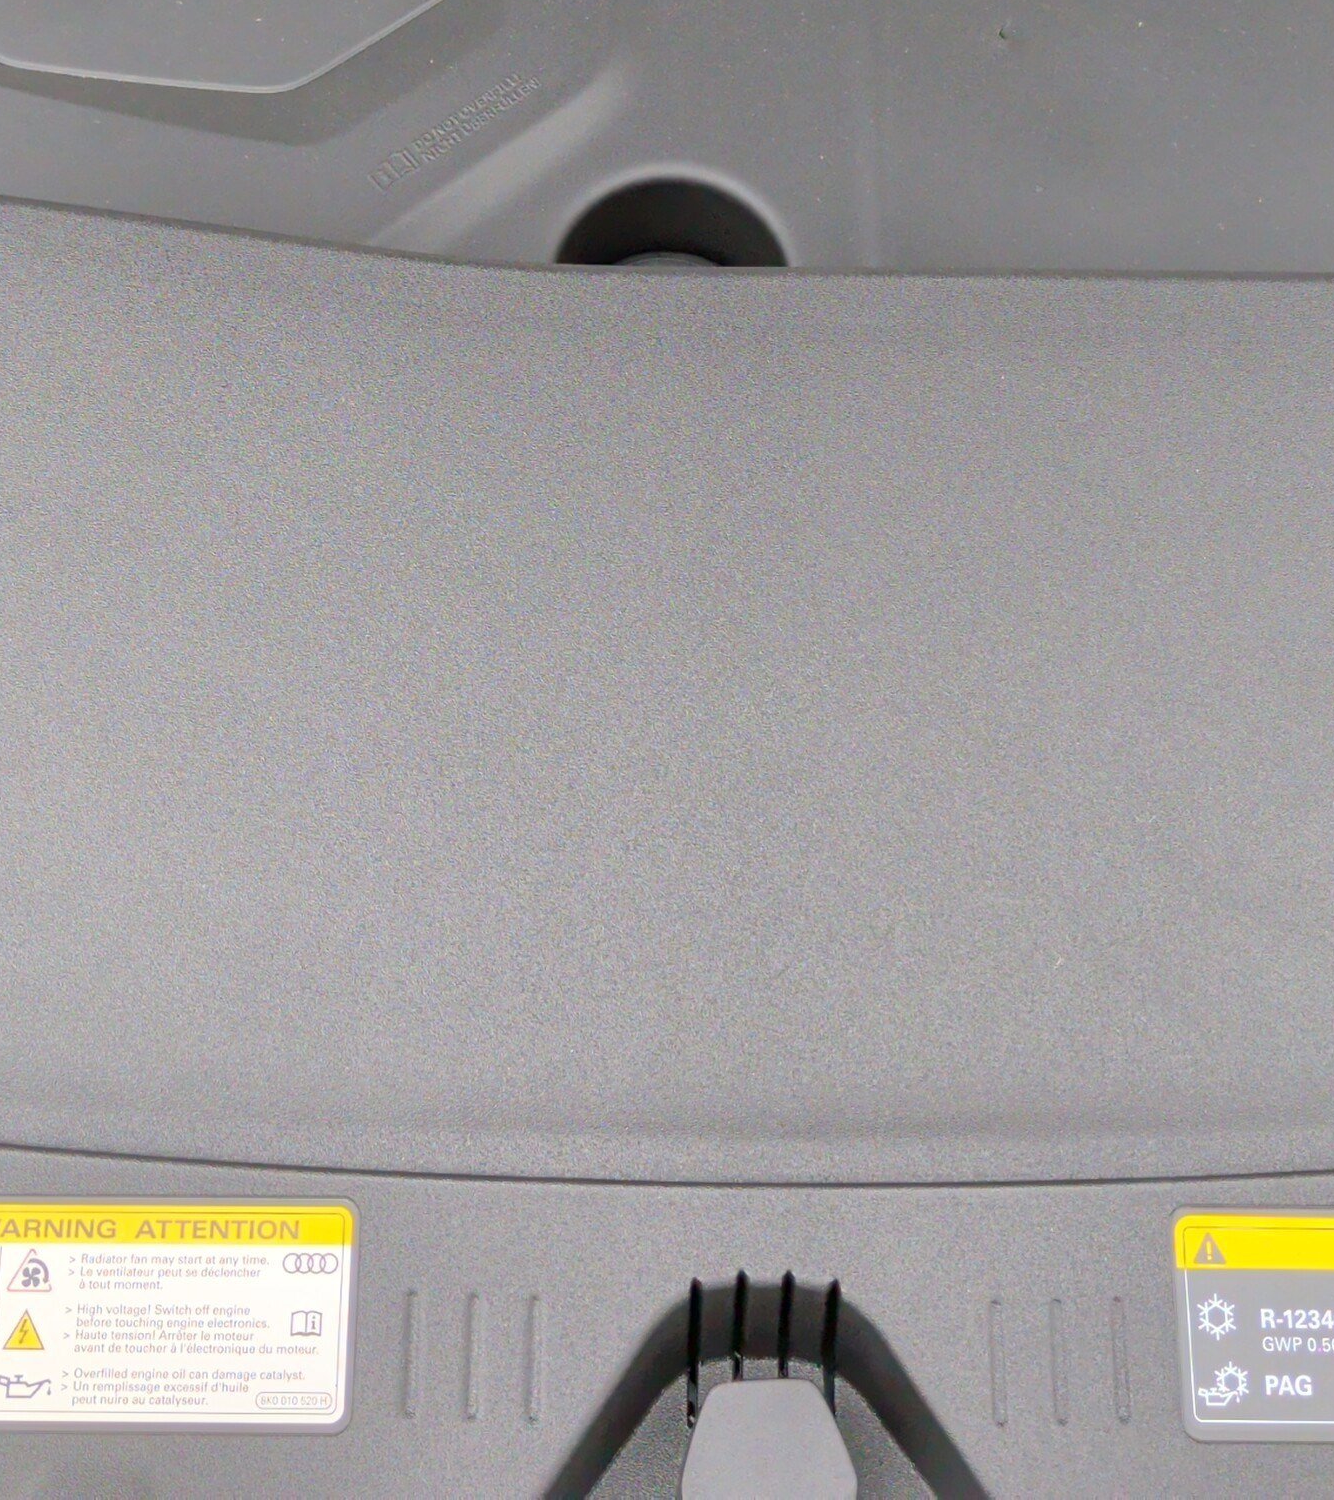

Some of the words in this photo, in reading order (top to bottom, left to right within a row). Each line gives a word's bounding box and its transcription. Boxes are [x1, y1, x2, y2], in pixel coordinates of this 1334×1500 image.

[135, 1220, 301, 1240] ATTENTION
[81, 1253, 127, 1265] Radiator
[130, 1254, 148, 1265] fan
[151, 1256, 175, 1268] may
[178, 1255, 203, 1266] start
[205, 1256, 217, 1266] at
[219, 1256, 239, 1268] any
[80, 1267, 93, 1277] Le
[96, 1267, 154, 1278] ventilateur
[158, 1268, 183, 1280] peut
[186, 1270, 198, 1279] se
[89, 1280, 111, 1290] tout
[77, 1303, 103, 1317] High
[155, 1304, 192, 1316] Switch
[195, 1304, 211, 1316] off
[213, 1306, 251, 1318] engine
[76, 1317, 112, 1329] before
[115, 1317, 164, 1331] touching
[167, 1318, 205, 1331] engine
[76, 1329, 107, 1341] Haute
[201, 1330, 211, 1341] le
[214, 1331, 255, 1342] moteur
[74, 1344, 106, 1354] avant
[108, 1342, 122, 1354] de
[125, 1342, 167, 1354] toucher
[259, 1344, 273, 1355] du
[1262, 1337, 1301, 1353] GWP
[74, 1367, 128, 1380] Overfilled
[131, 1369, 169, 1382] engine
[172, 1368, 187, 1380] oil
[189, 1370, 209, 1380] can
[211, 1368, 257, 1383] damage
[73, 1381, 90, 1392] Un
[92, 1381, 161, 1394] remplissage
[163, 1381, 209, 1393] excessif
[1265, 1374, 1314, 1396] PAG
[72, 1394, 97, 1407] peut
[100, 1394, 128, 1406] nuire
[131, 1396, 146, 1406] au
